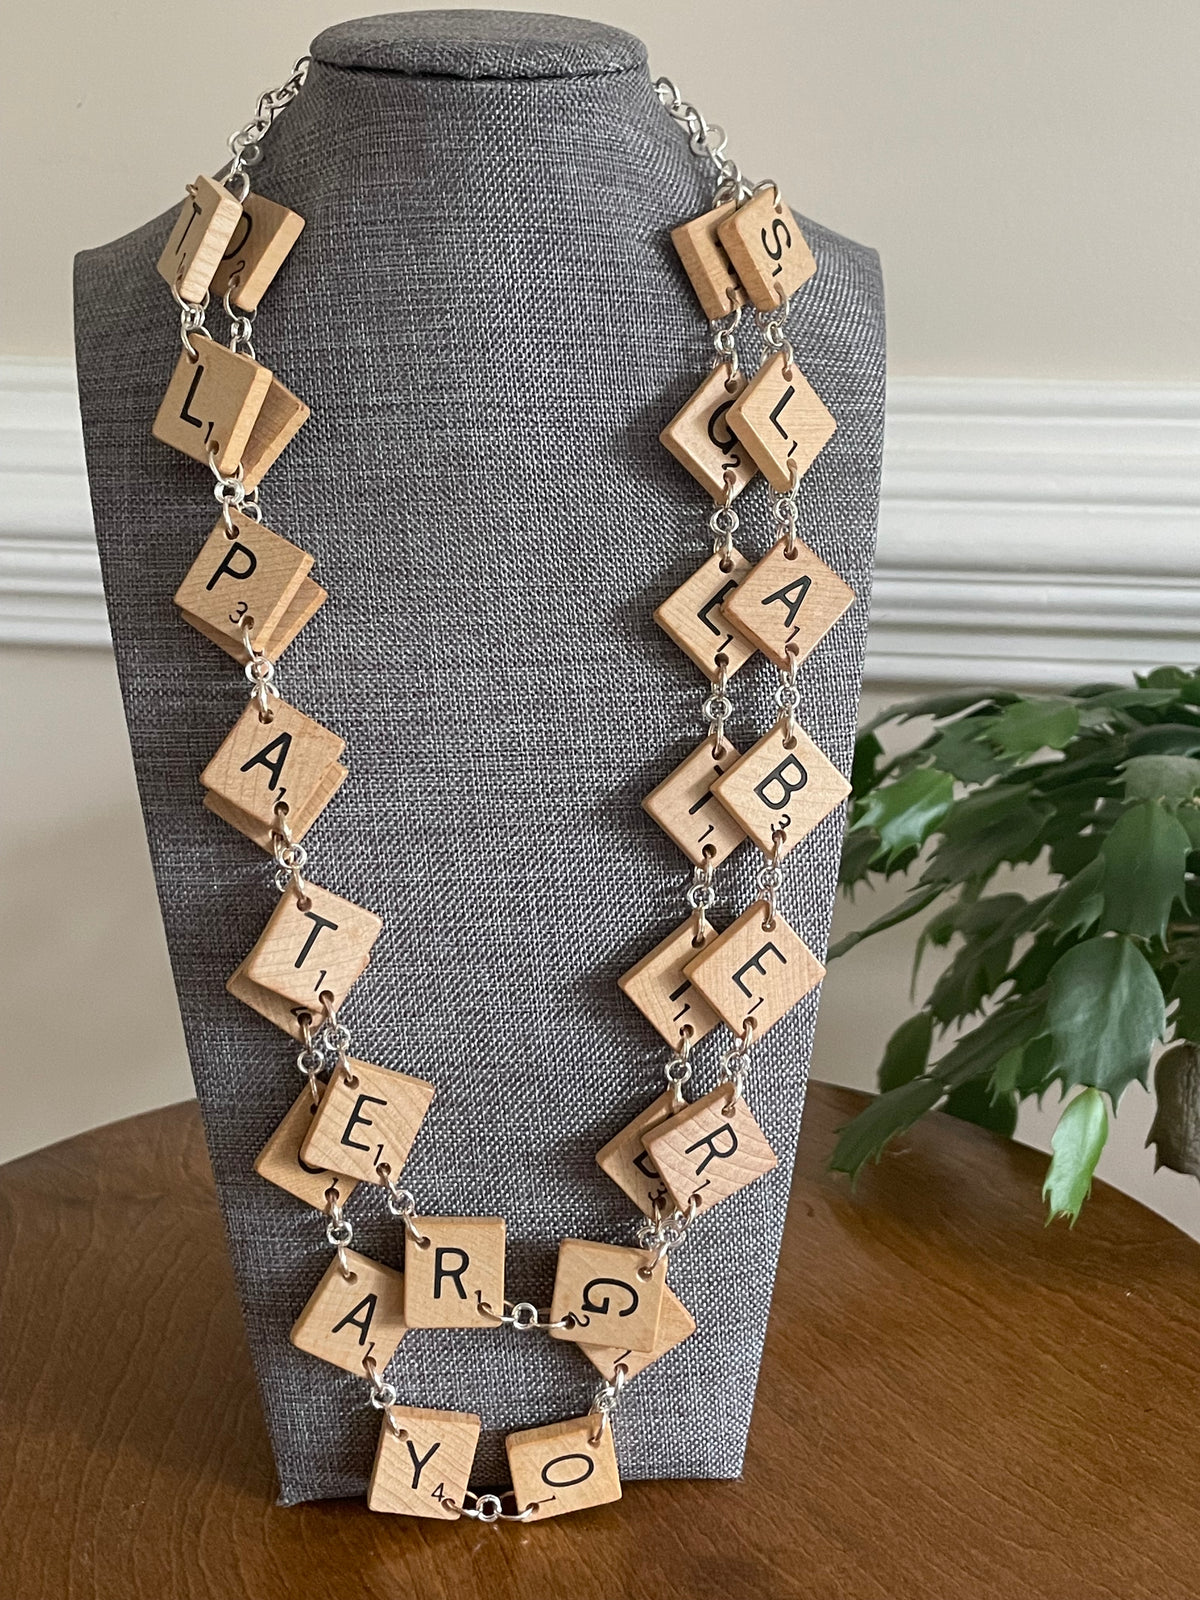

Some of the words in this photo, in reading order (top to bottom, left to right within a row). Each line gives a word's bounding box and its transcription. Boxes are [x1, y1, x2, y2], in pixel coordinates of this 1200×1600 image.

[761, 218, 791, 261] S
[180, 365, 204, 428] L
[769, 385, 795, 440] L
[205, 541, 258, 592] P
[761, 575, 812, 628] A
[240, 731, 293, 791] A
[753, 753, 808, 810] B
[294, 912, 338, 969] T
[732, 942, 787, 998] E
[340, 1094, 387, 1151] E
[685, 1122, 738, 1176] R
[433, 1247, 470, 1300] R
[580, 1277, 639, 1318] G
[331, 1292, 378, 1346] A
[406, 1440, 441, 1489] Y
[541, 1453, 595, 1487] O
